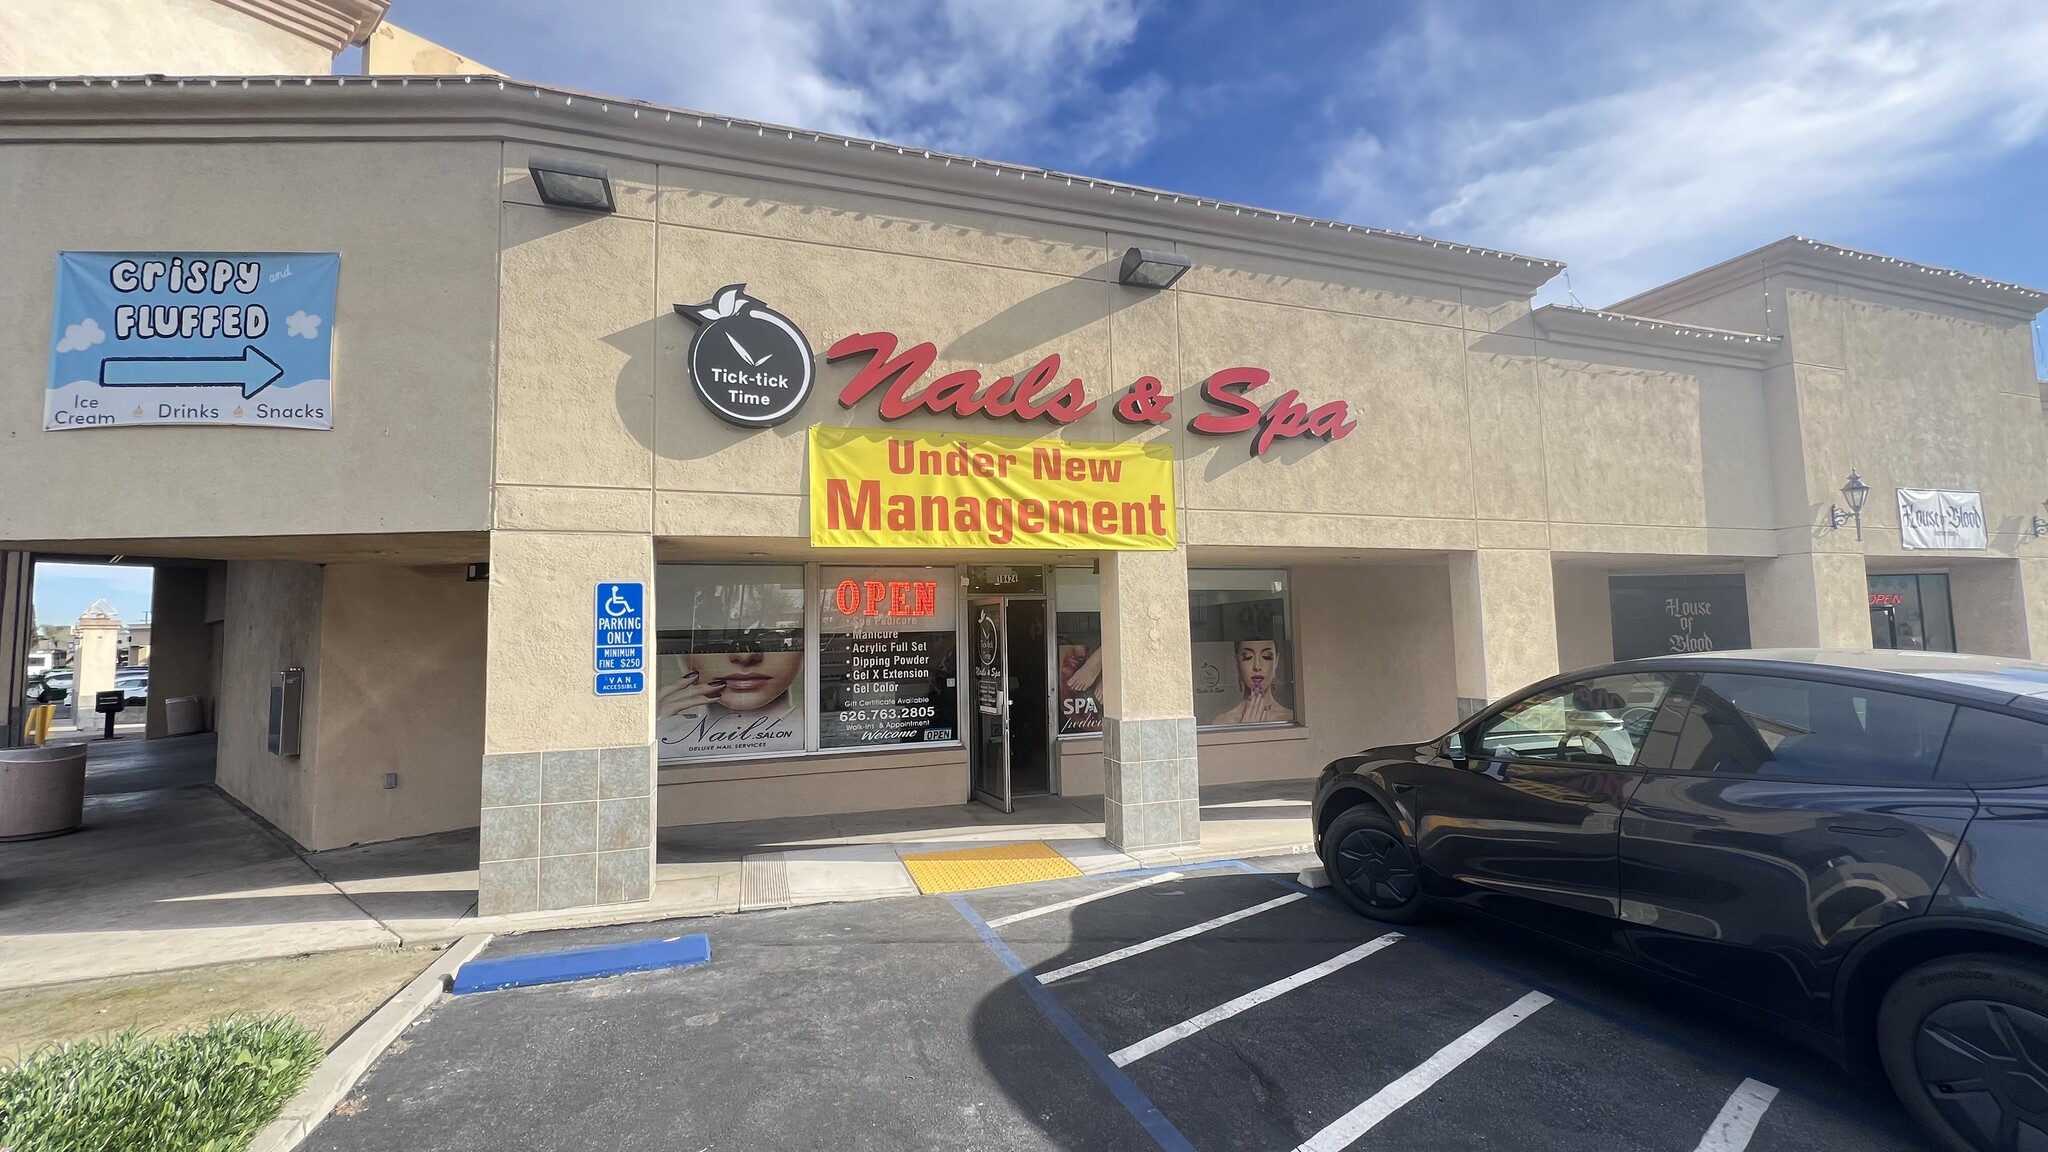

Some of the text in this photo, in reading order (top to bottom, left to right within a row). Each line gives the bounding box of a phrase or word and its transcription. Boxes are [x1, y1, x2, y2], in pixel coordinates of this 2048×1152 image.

[269, 264, 292, 283] and
[115, 304, 269, 340] FLUFFED
[711, 367, 789, 389] Tick-tick
[728, 390, 770, 406] Time
[827, 331, 1357, 458] Nails & Spa
[74, 395, 99, 409] Ice
[54, 410, 116, 425] Cream
[158, 404, 219, 419] Drinks
[256, 404, 324, 419] Snacks
[888, 440, 1122, 483] Under New
[826, 478, 1166, 545] Management
[1902, 503, 1940, 529] House
[1946, 504, 1982, 529] Blood
[836, 579, 937, 616] OPEN
[1868, 593, 1904, 605] OPEN
[1665, 598, 1711, 617] House
[598, 617, 641, 630] PARKING
[853, 616, 917, 627] Spa Pedicure
[1680, 616, 1694, 634] of
[606, 631, 633, 644] ONLY
[853, 628, 899, 640] Manicure
[852, 641, 927, 655] Acrylic Full Set
[1669, 631, 1713, 652] Blood
[604, 648, 635, 658] MINIMUM
[599, 658, 640, 668] FINE $250
[853, 654, 929, 668] Dipping Powder
[609, 676, 631, 684] VAN
[853, 668, 929, 681] Gel X Extension
[602, 683, 637, 691] ACCESSIBLE
[853, 682, 899, 694] Gel Color
[844, 696, 930, 707] Gift Certificate Available
[1063, 697, 1099, 715] SPA
[839, 706, 935, 722] 626.763.2805
[661, 712, 768, 745] Nail
[885, 719, 930, 730] Appointment
[861, 729, 918, 740] Welcome
[926, 729, 951, 740] OPEN
